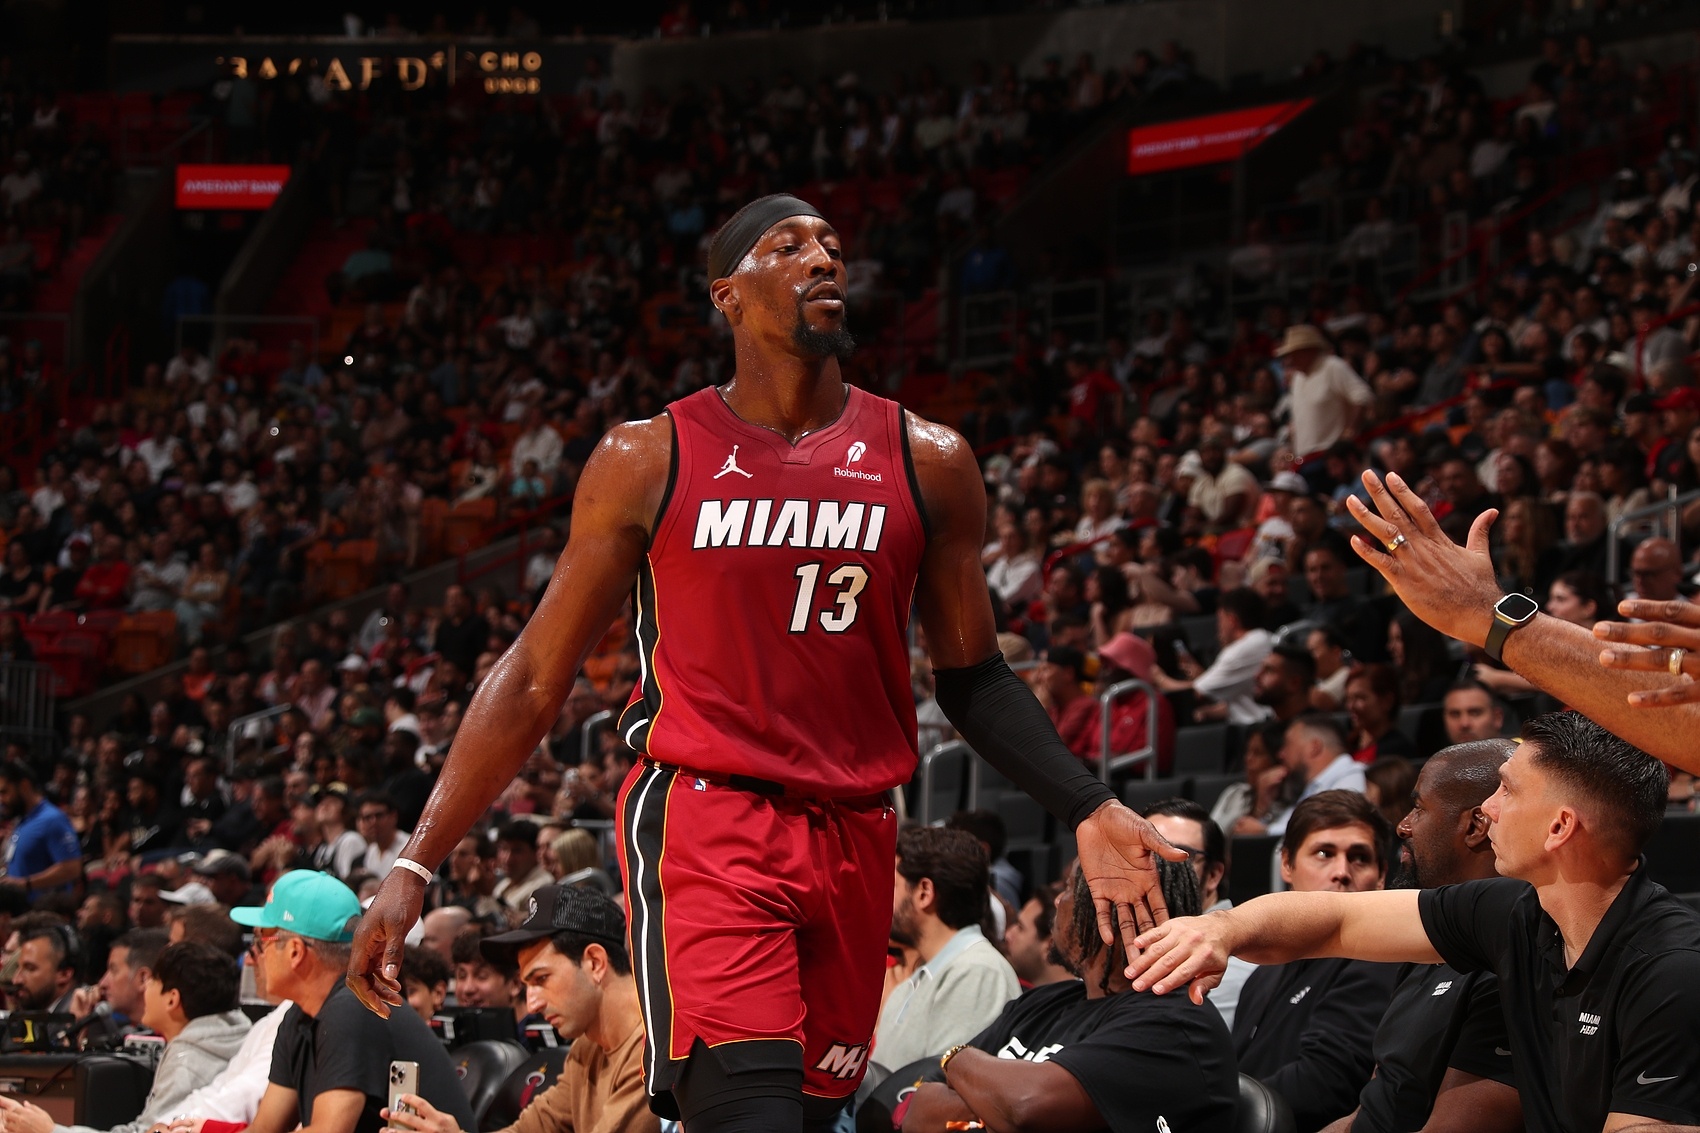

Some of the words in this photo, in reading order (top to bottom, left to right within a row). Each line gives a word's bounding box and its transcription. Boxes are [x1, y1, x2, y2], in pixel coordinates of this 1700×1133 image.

[464, 51, 542, 72] CHO
[833, 467, 882, 481] Robinhood
[692, 499, 887, 552] MIAMI
[788, 561, 869, 634] 13
